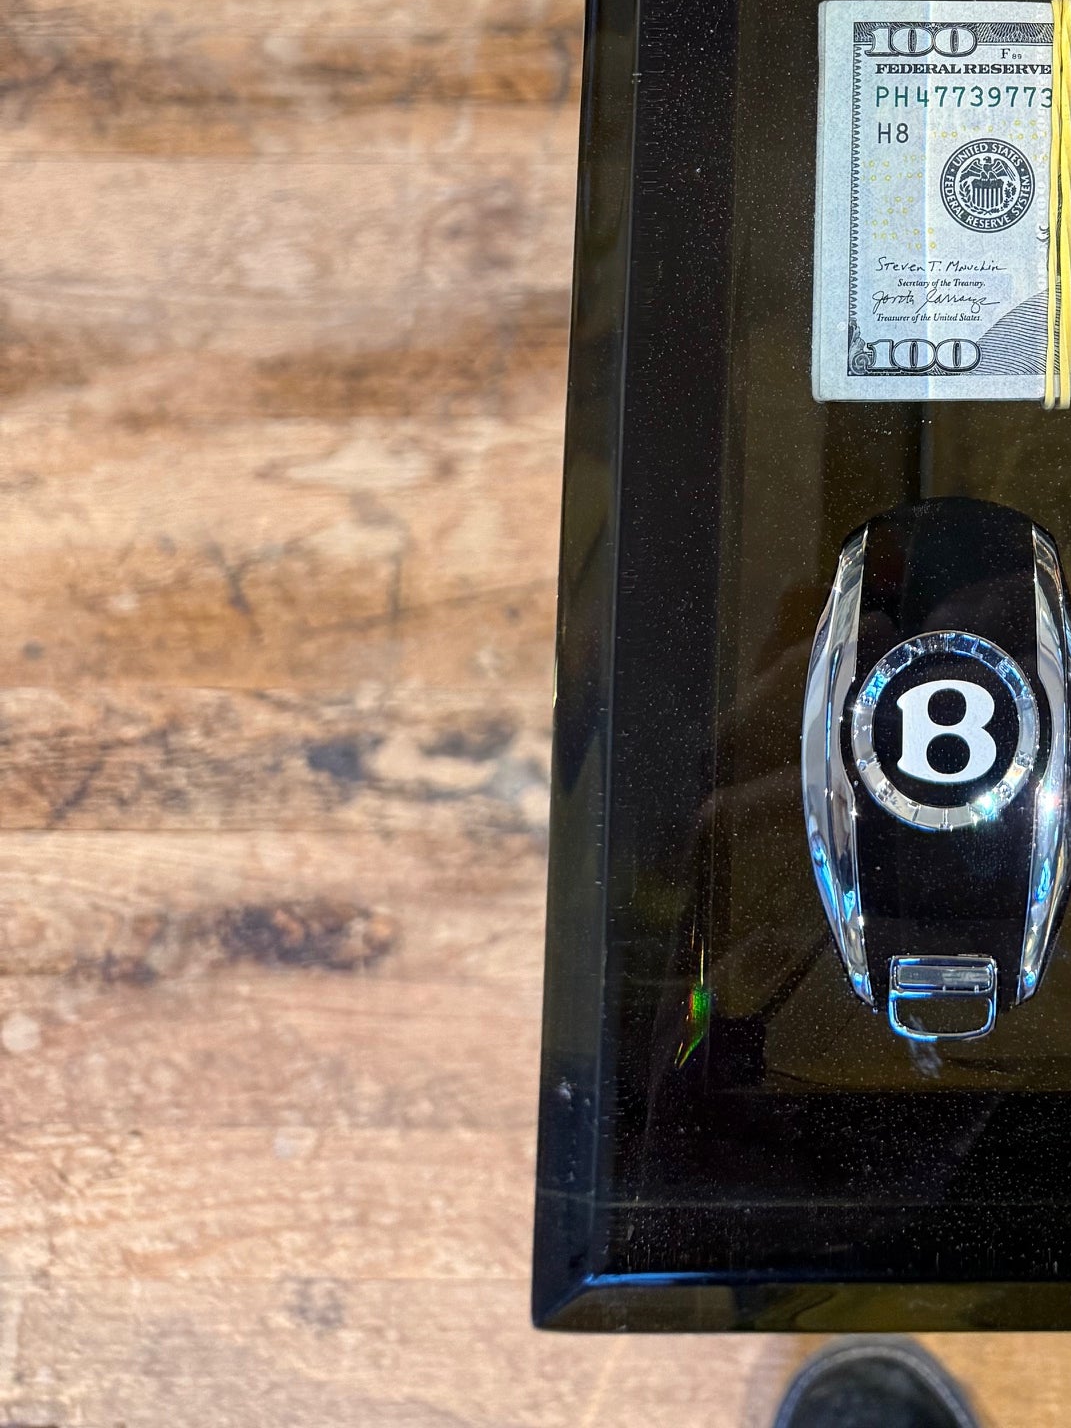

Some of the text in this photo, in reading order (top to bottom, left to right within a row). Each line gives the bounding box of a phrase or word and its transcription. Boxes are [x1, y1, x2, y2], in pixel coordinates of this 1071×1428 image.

[864, 27, 978, 57] 100
[875, 63, 961, 75] FEDERAL
[963, 63, 1052, 75] RESERVE
[878, 121, 909, 144] H8
[952, 142, 1023, 167] UNITED STATES
[944, 174, 965, 218] FEDERAL
[965, 213, 1012, 229] RESERVE
[1011, 174, 1031, 217] SYSTEM
[898, 278, 930, 289] Secretary
[940, 278, 951, 288] the
[876, 313, 911, 323] Treasurer
[933, 313, 958, 323] United
[867, 338, 982, 372] 100
